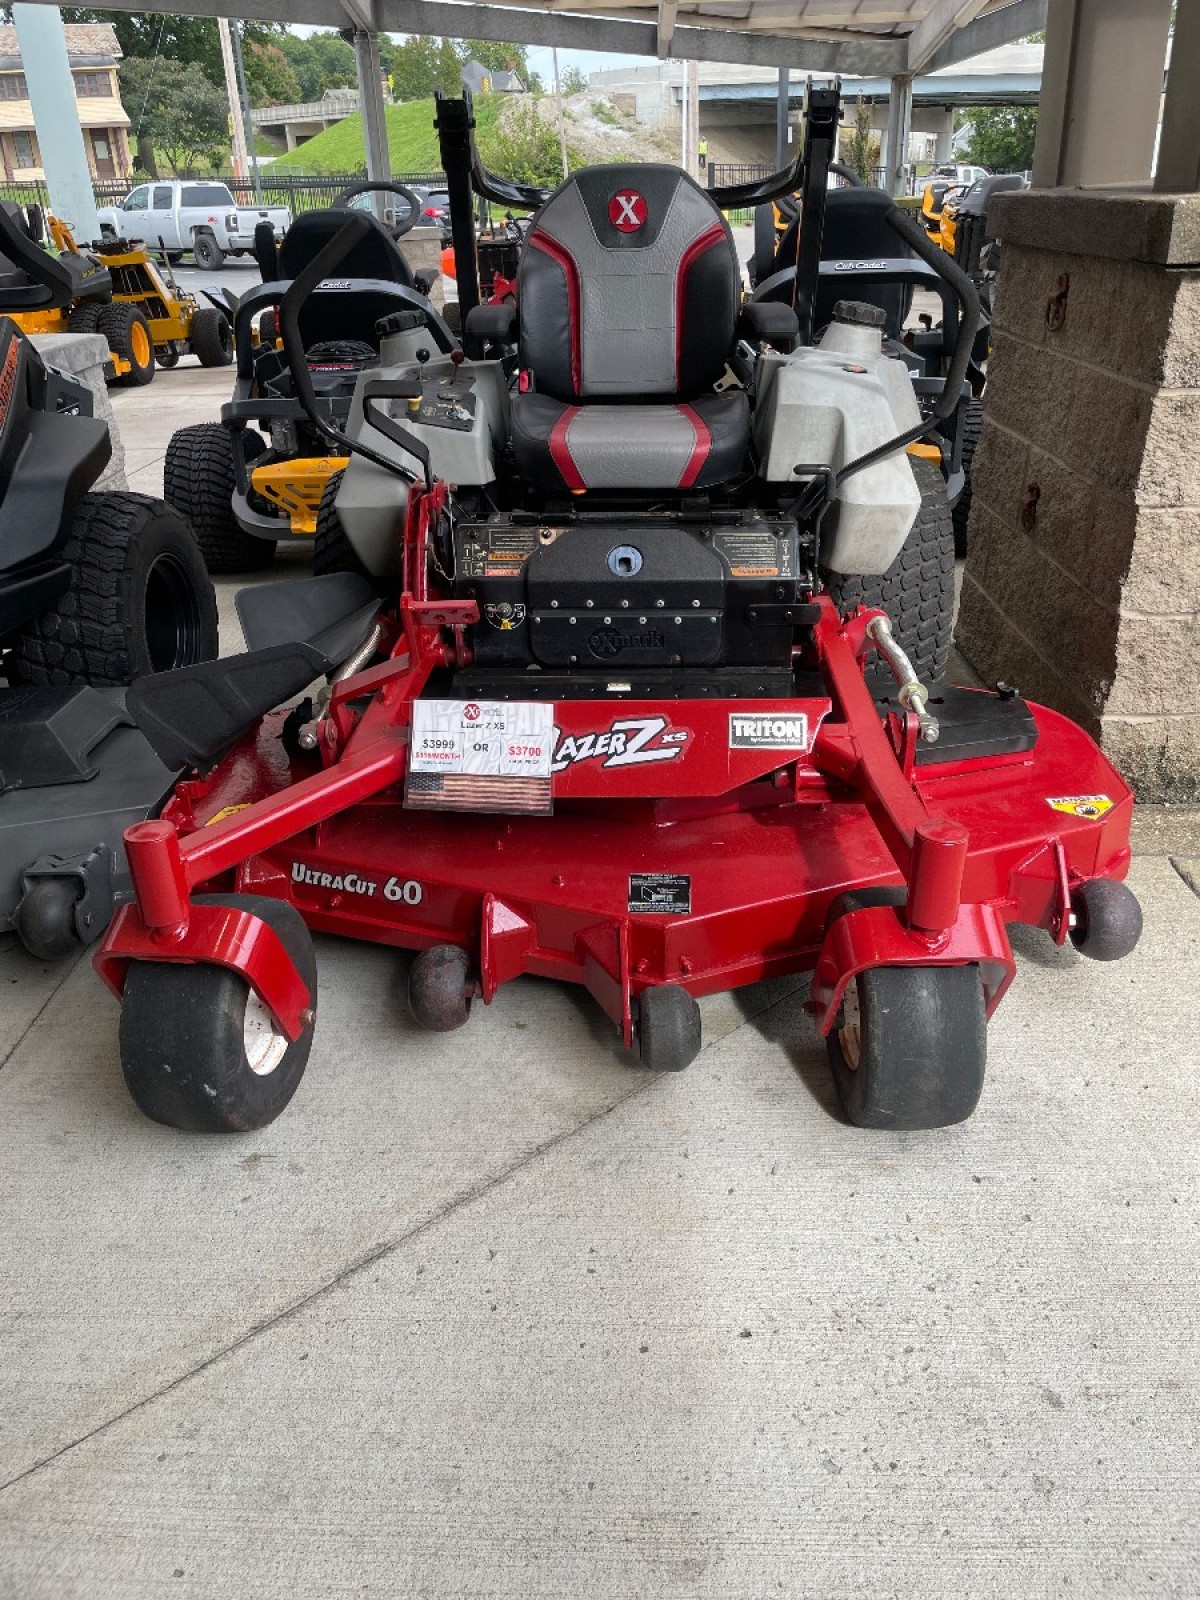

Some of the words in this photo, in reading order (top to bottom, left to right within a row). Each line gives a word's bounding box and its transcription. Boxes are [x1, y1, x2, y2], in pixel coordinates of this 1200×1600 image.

[615, 195, 641, 225] X
[855, 261, 888, 269] Cadet
[733, 720, 802, 737] TRITON
[422, 738, 456, 750] $3999
[472, 742, 489, 753] OR
[508, 745, 542, 757] $3700
[383, 876, 422, 905] 60
